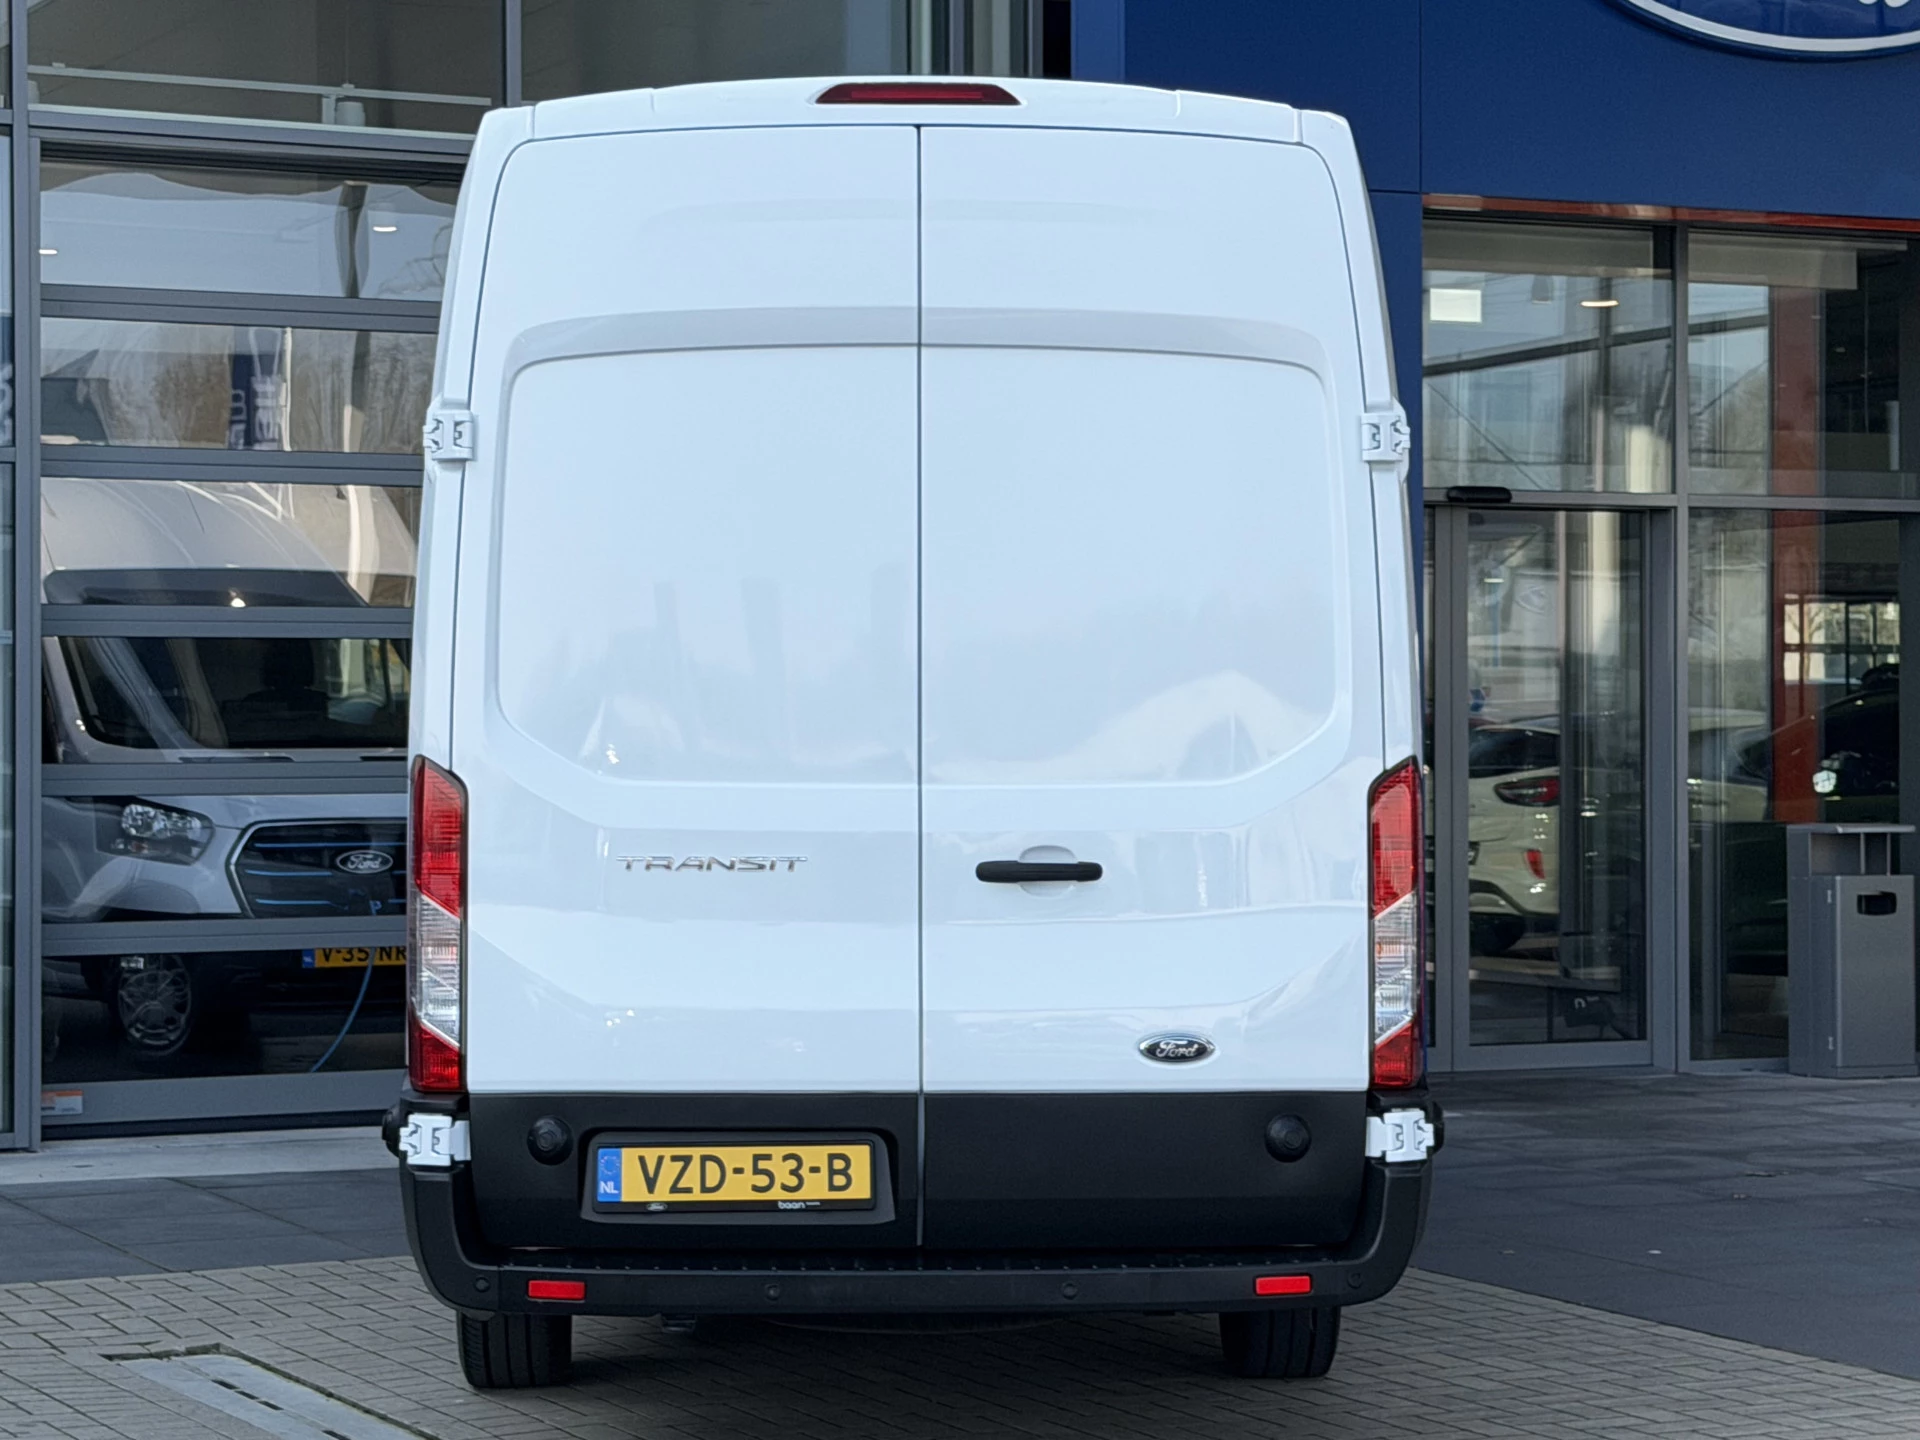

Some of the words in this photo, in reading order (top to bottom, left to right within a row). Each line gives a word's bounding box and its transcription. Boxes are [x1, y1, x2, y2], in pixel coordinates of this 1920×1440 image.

[347, 854, 382, 869] Ford
[615, 856, 808, 872] TRANSIT
[1155, 1040, 1199, 1057] Ford
[600, 1181, 619, 1195] NL
[638, 1152, 853, 1195] VZD-53-B
[778, 1201, 806, 1209] baan
